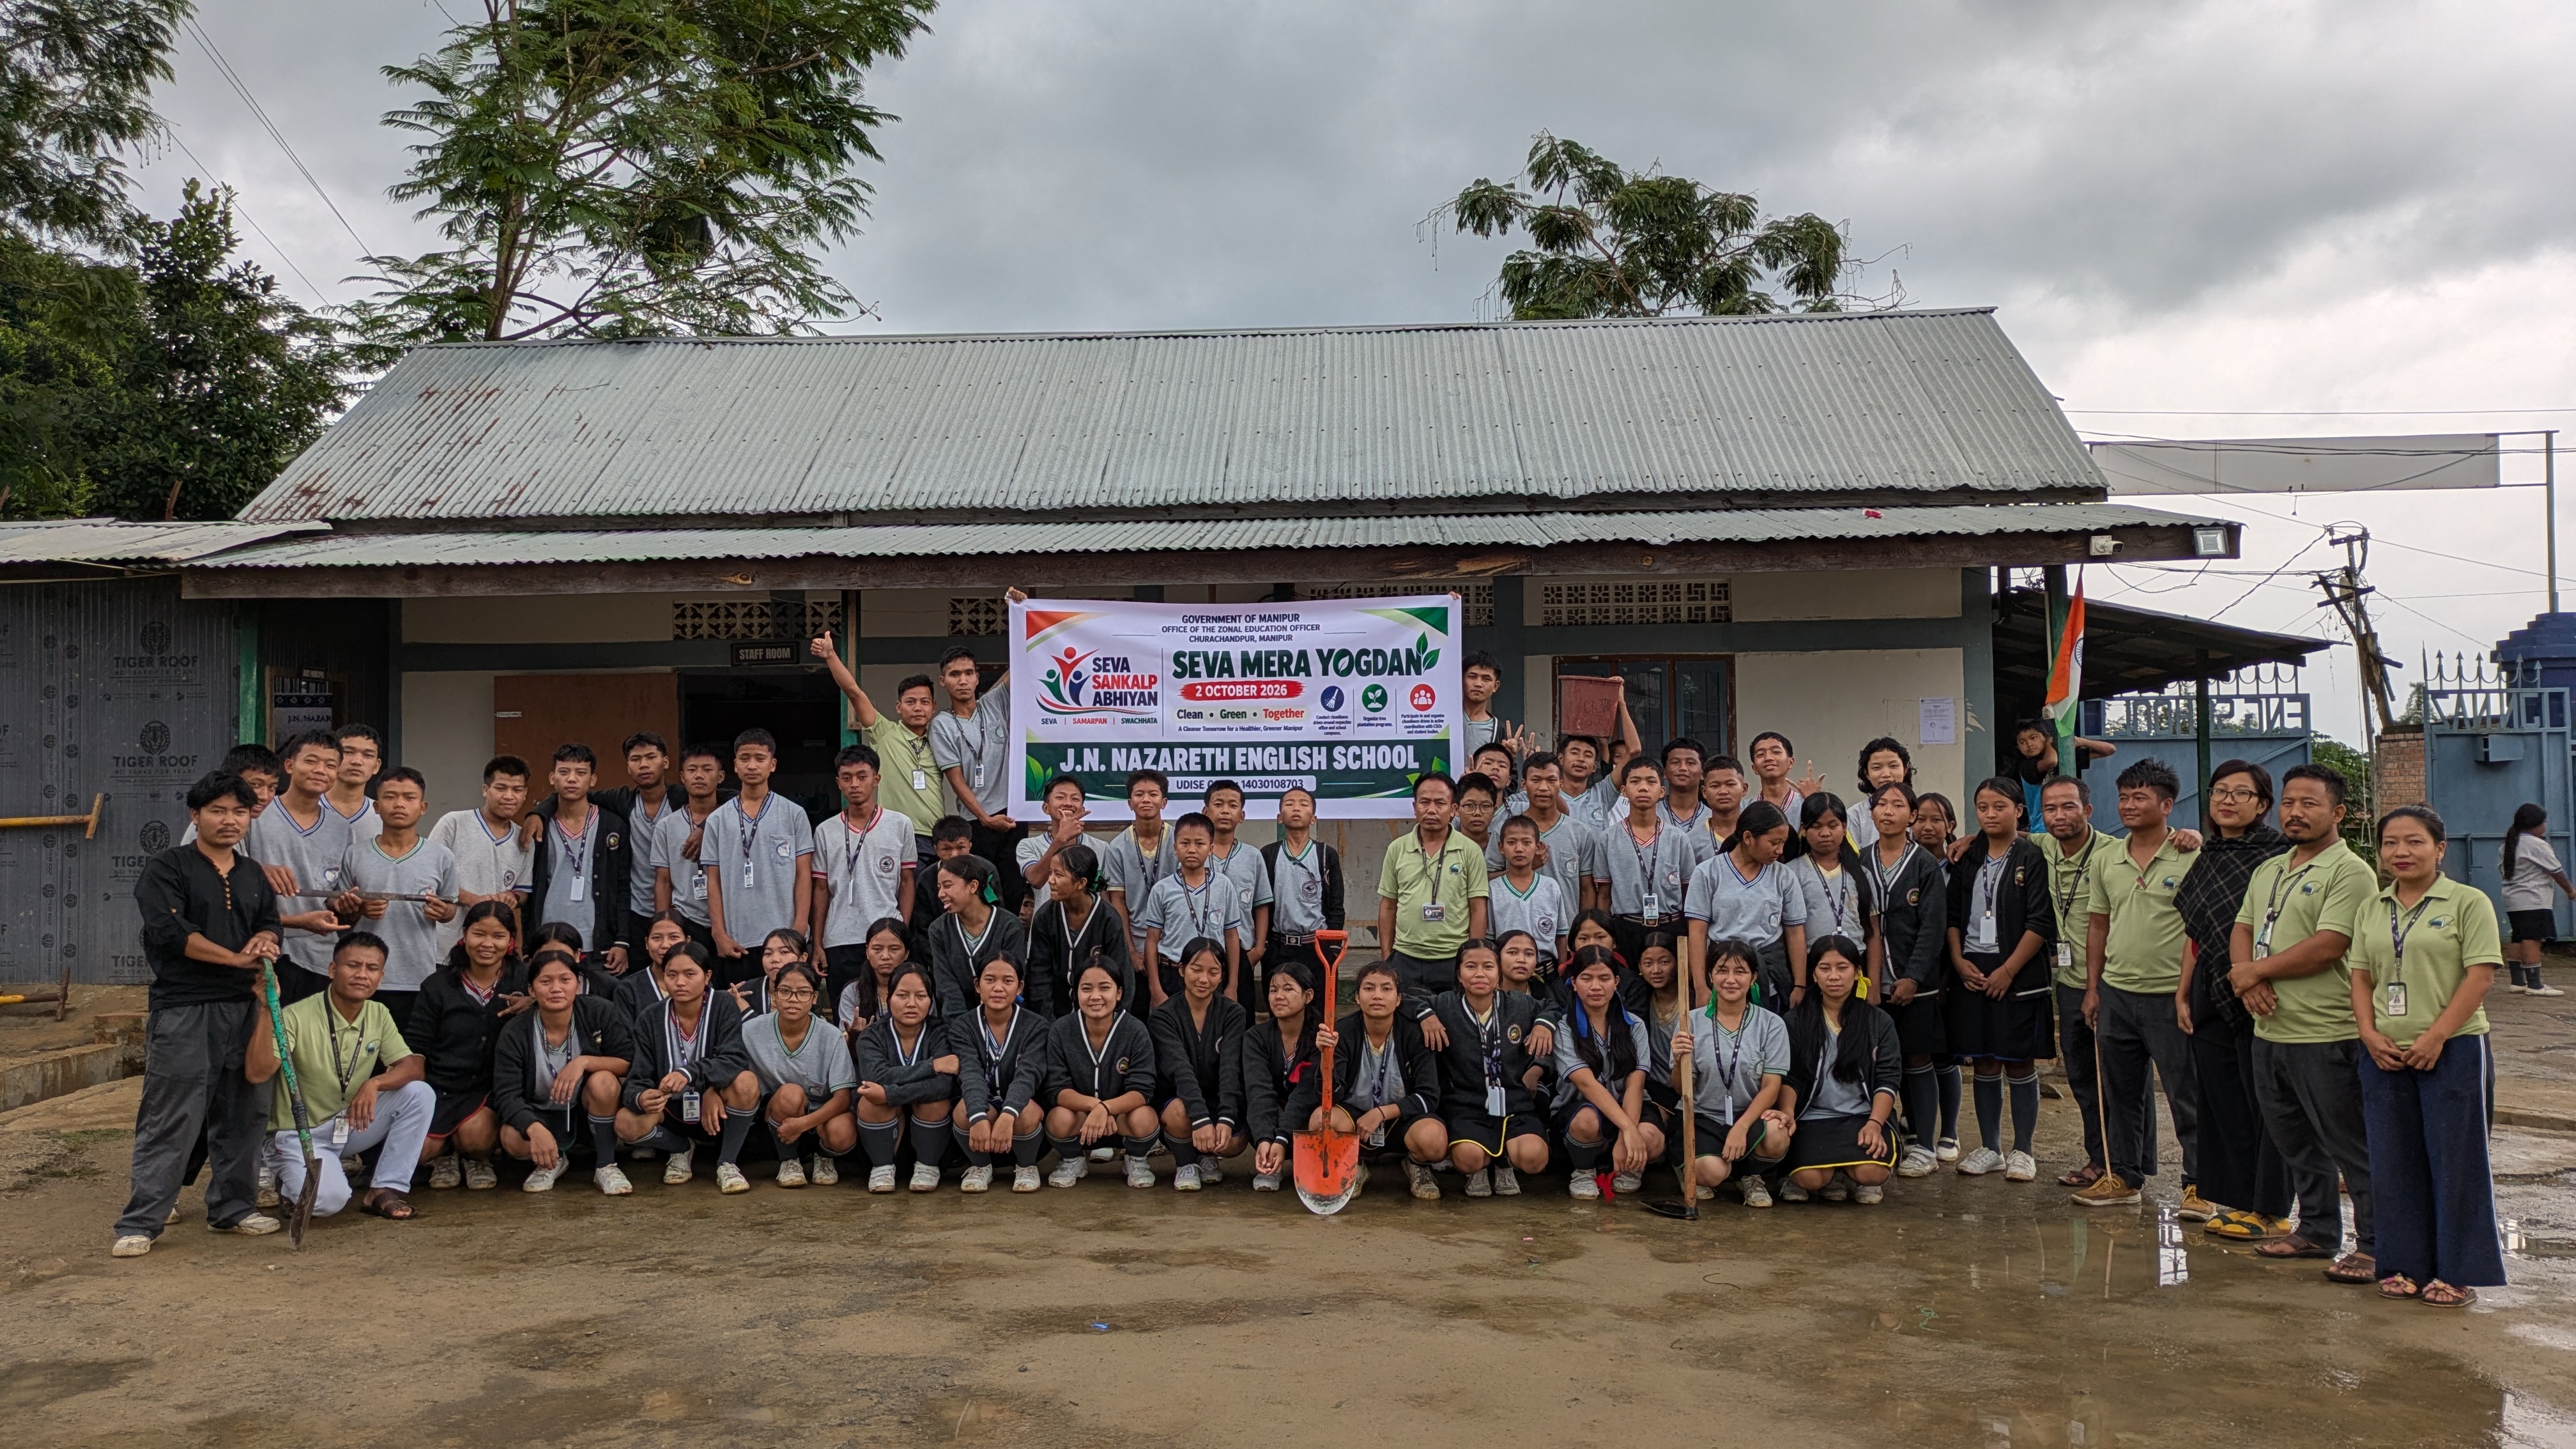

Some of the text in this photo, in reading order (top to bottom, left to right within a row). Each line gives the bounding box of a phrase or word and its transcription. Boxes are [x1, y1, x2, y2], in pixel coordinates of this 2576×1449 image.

[1182, 613, 1300, 624] GOVERNMENT OF MANIPUR
[739, 648, 790, 659] STAFF ROOM
[112, 655, 198, 668] TIGER ROOF
[1092, 657, 1130, 673] SEVA
[1172, 648, 1422, 678] SEVA MERA YOGDAN
[1092, 675, 1158, 689] SANKALP
[1195, 684, 1287, 696] 2 OCTOBER 2026
[1092, 691, 1158, 706] ABHIYAN
[1177, 708, 1304, 721] Clean Green Together
[112, 755, 198, 768] TIGER ROOF
[1060, 745, 1419, 772] J.N. NAZARETH ENGLISH SCHOOL
[1177, 780, 1205, 789] UDISE
[1241, 779, 1303, 789] 14030108703
